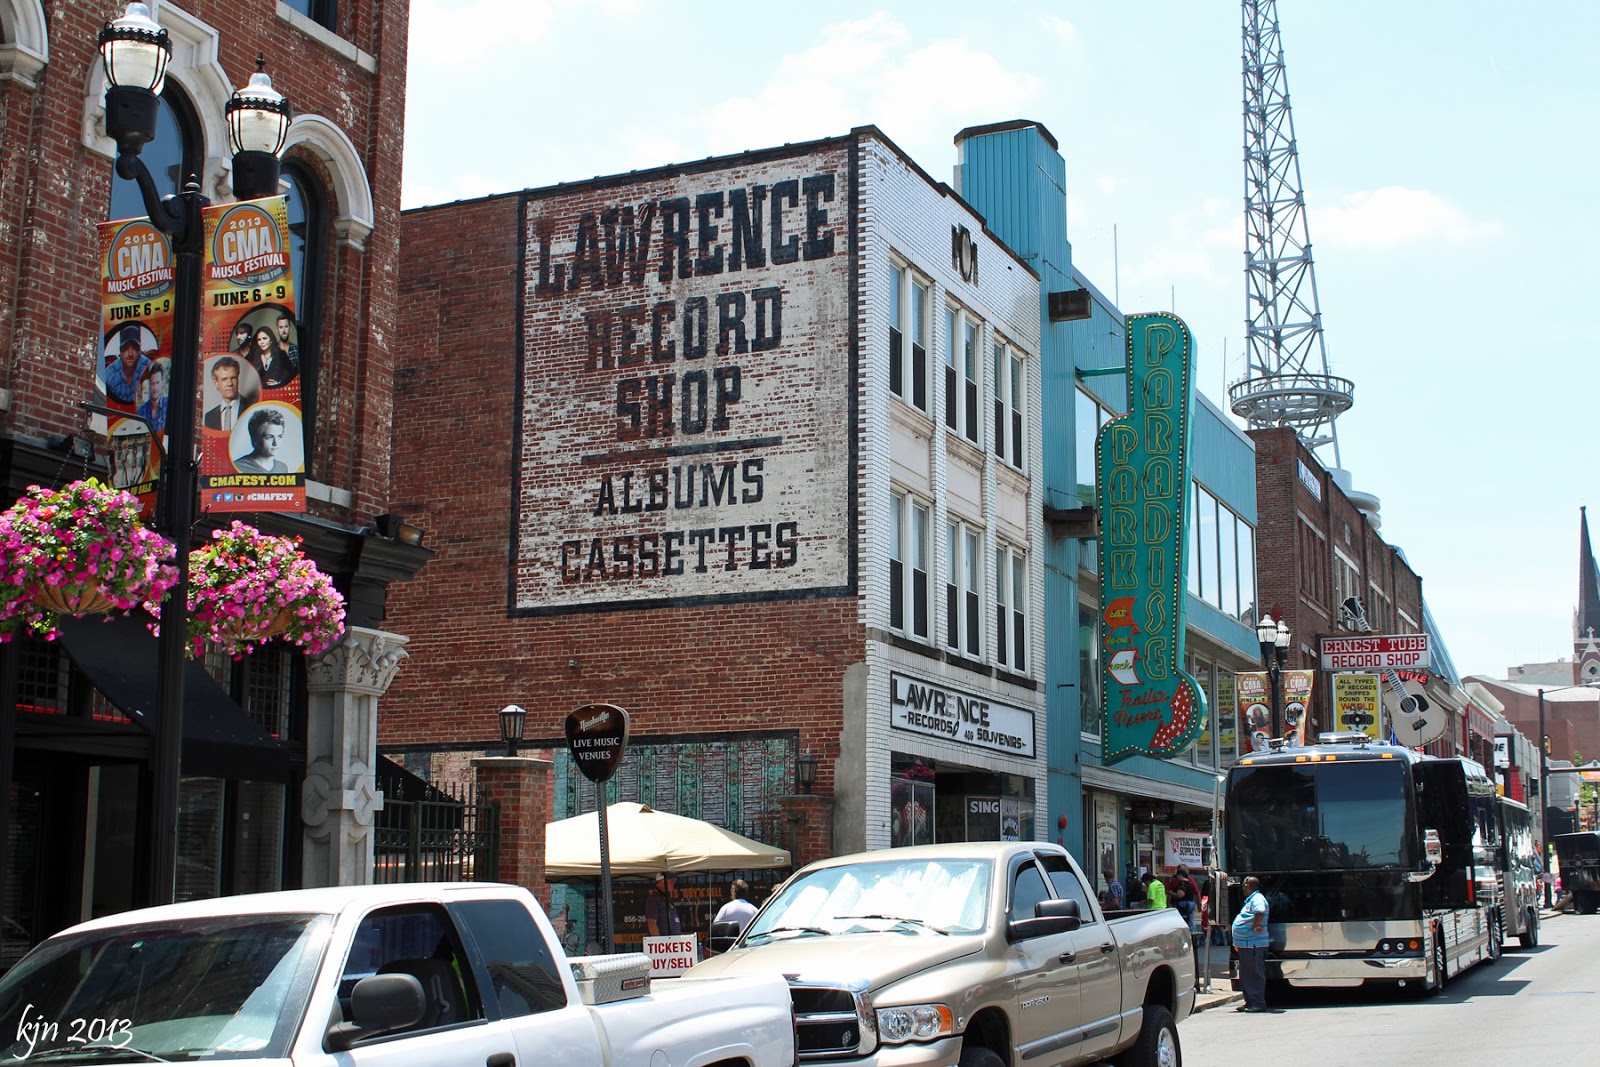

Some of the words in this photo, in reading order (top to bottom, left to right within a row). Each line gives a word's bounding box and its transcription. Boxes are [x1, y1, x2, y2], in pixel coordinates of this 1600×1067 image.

[230, 217, 261, 229] 2013
[124, 233, 154, 244] 2013
[222, 226, 272, 263] CMA
[535, 174, 835, 296] LAWRENCE
[118, 242, 164, 278] CMA
[212, 263, 242, 278] MUSIC
[244, 254, 285, 272] FESTIVAL
[108, 278, 135, 292] MUSIC
[138, 268, 172, 288] FESTIVAL
[213, 290, 248, 306] JUNE
[253, 289, 262, 302] 6
[276, 286, 286, 299] 9
[110, 304, 140, 320] JUNE
[144, 303, 152, 316] 6
[163, 300, 170, 312] 9
[584, 286, 782, 371] RECORD
[616, 366, 741, 441] SHOP
[210, 474, 296, 488] CMAFEST.COM
[594, 458, 764, 516] ALBUMS
[246, 492, 294, 502] #CMAFEST
[1142, 323, 1176, 680] PARADISE
[1108, 425, 1138, 590] PARK
[562, 522, 798, 584] CASSETTES
[1324, 638, 1380, 654] ERNEST
[1388, 636, 1426, 650] TUBB
[1332, 654, 1382, 668] RECORD
[1387, 652, 1420, 666] SHOP
[1244, 680, 1260, 690] CMA
[1290, 678, 1307, 688] CMA
[892, 678, 990, 727] LAWRENCE
[1120, 690, 1168, 708] Trailer
[1114, 708, 1162, 728] Resort
[908, 711, 952, 734] RECORDS
[976, 728, 1022, 749] SOUVENIRS
[574, 738, 592, 748] LIVE
[594, 736, 620, 746] MUSIC
[579, 750, 610, 761] VENUES
[970, 800, 1000, 814] SING
[624, 915, 647, 923] 856-26
[648, 942, 692, 954] TICKETS
[652, 958, 694, 970] UY/SELL
